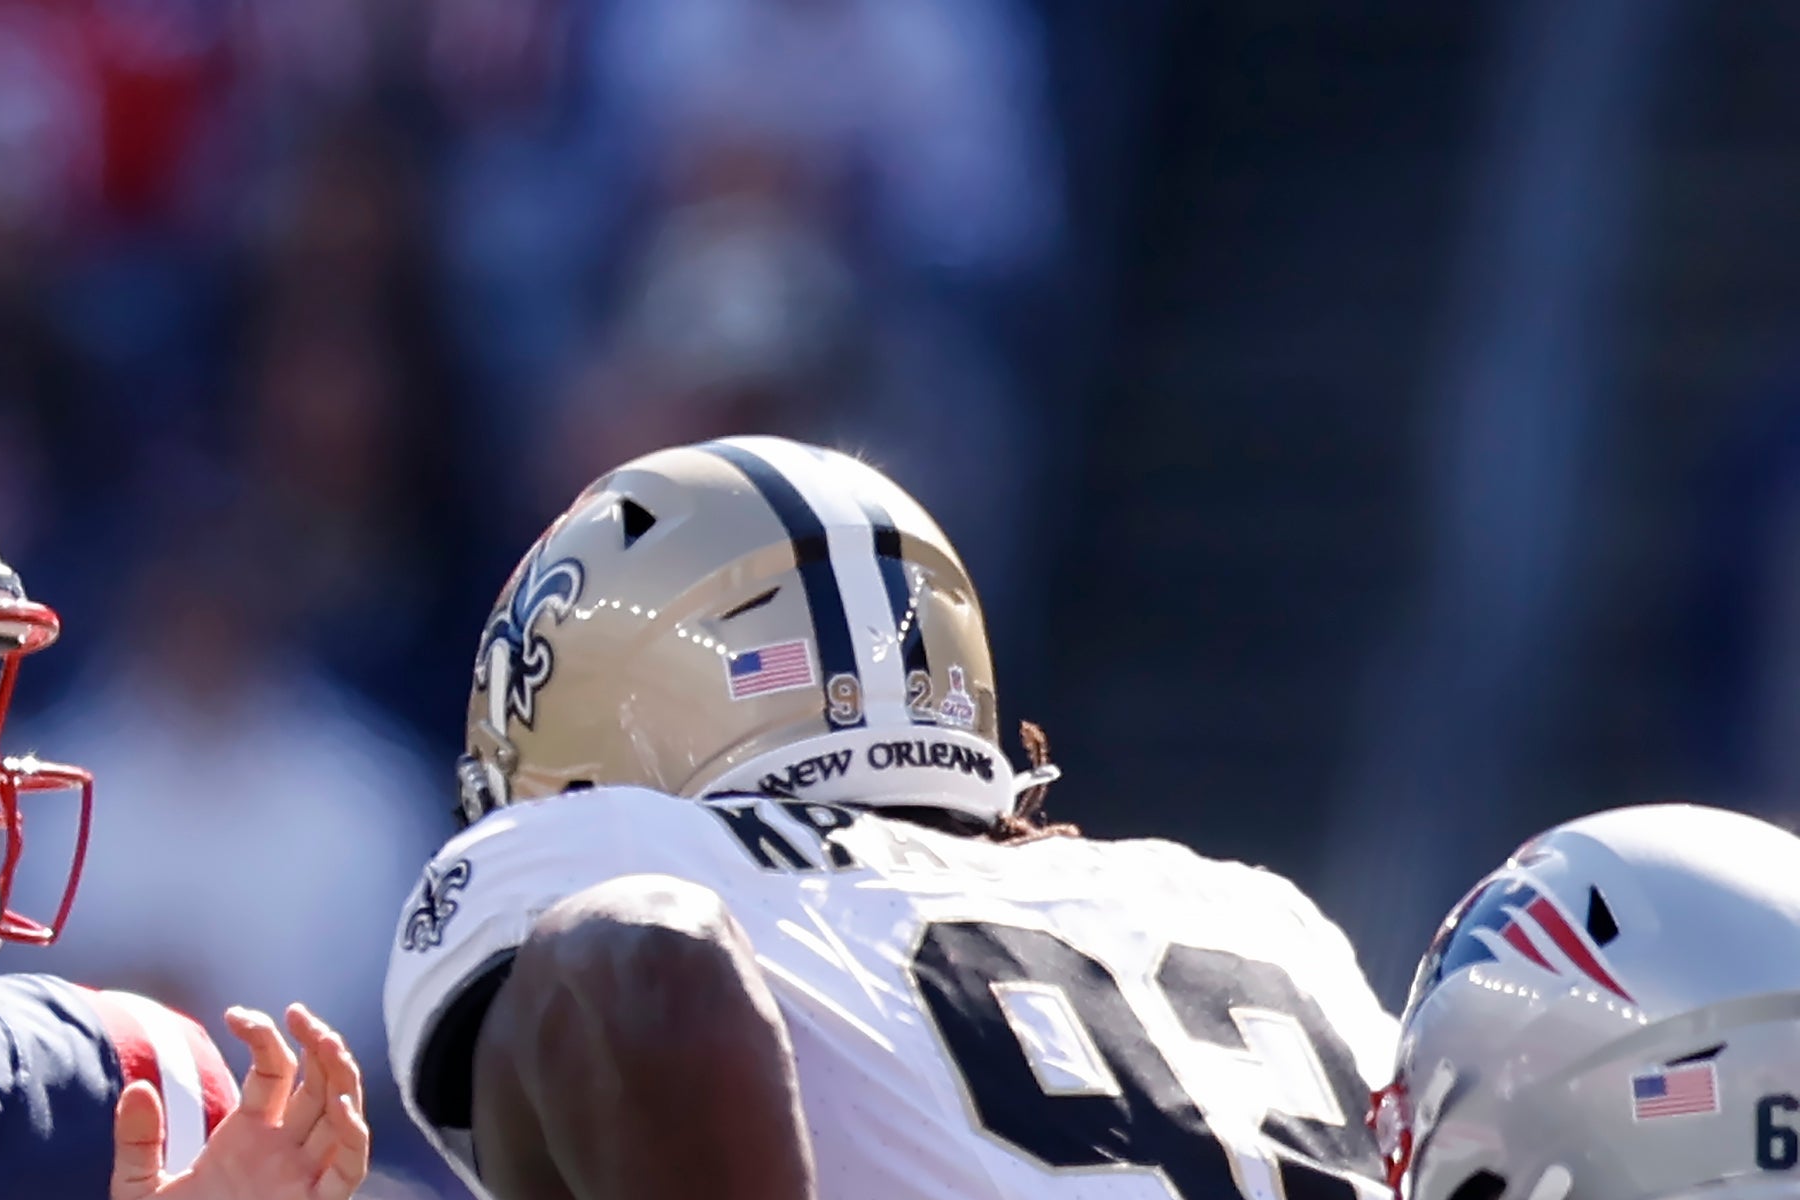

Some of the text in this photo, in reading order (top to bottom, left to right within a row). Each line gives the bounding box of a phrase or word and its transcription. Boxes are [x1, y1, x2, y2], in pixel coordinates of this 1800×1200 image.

[826, 669, 938, 726] 9 2
[758, 748, 853, 792] NEW
